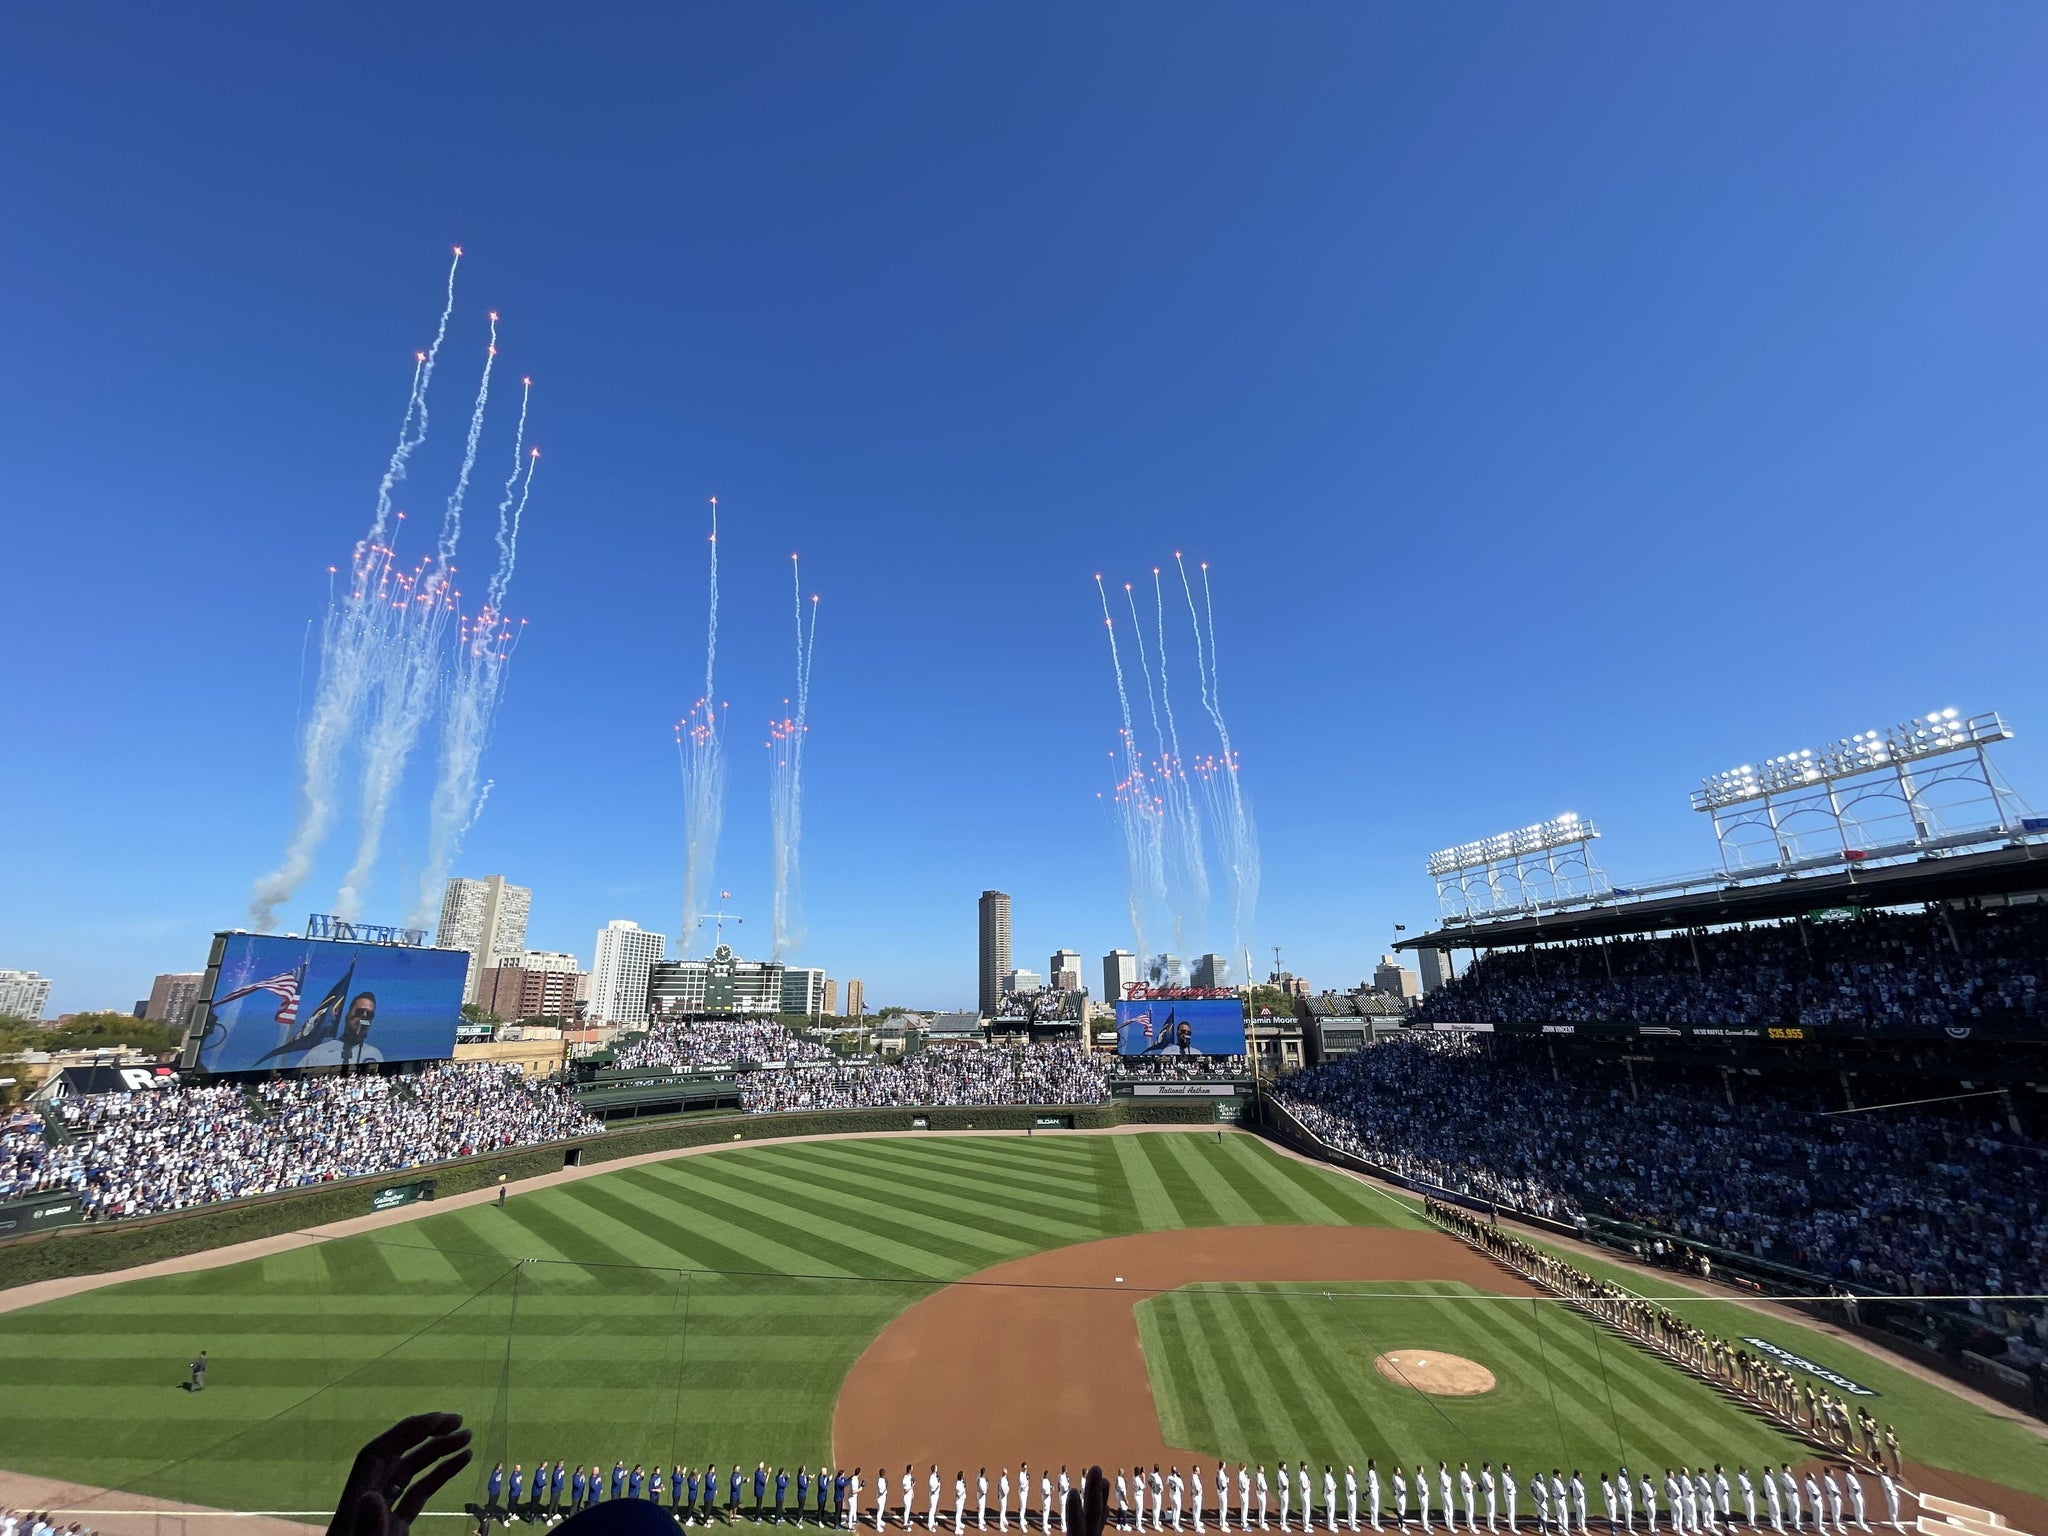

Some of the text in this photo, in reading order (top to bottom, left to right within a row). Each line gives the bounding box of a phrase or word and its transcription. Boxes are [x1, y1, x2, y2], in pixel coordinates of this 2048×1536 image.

[305, 913, 429, 946] WINTRUST
[1122, 981, 1235, 1000] Budweiser
[1542, 1025, 1575, 1033] JOHN VINCENT
[1768, 1028, 1804, 1039] $35,955
[671, 1066, 693, 1074] YETI
[1158, 1086, 1211, 1094] National Anthem
[374, 1194, 404, 1204] Gallagher
[45, 1206, 72, 1215] BOSCH
[1743, 1338, 1874, 1395] POSTSEASON
